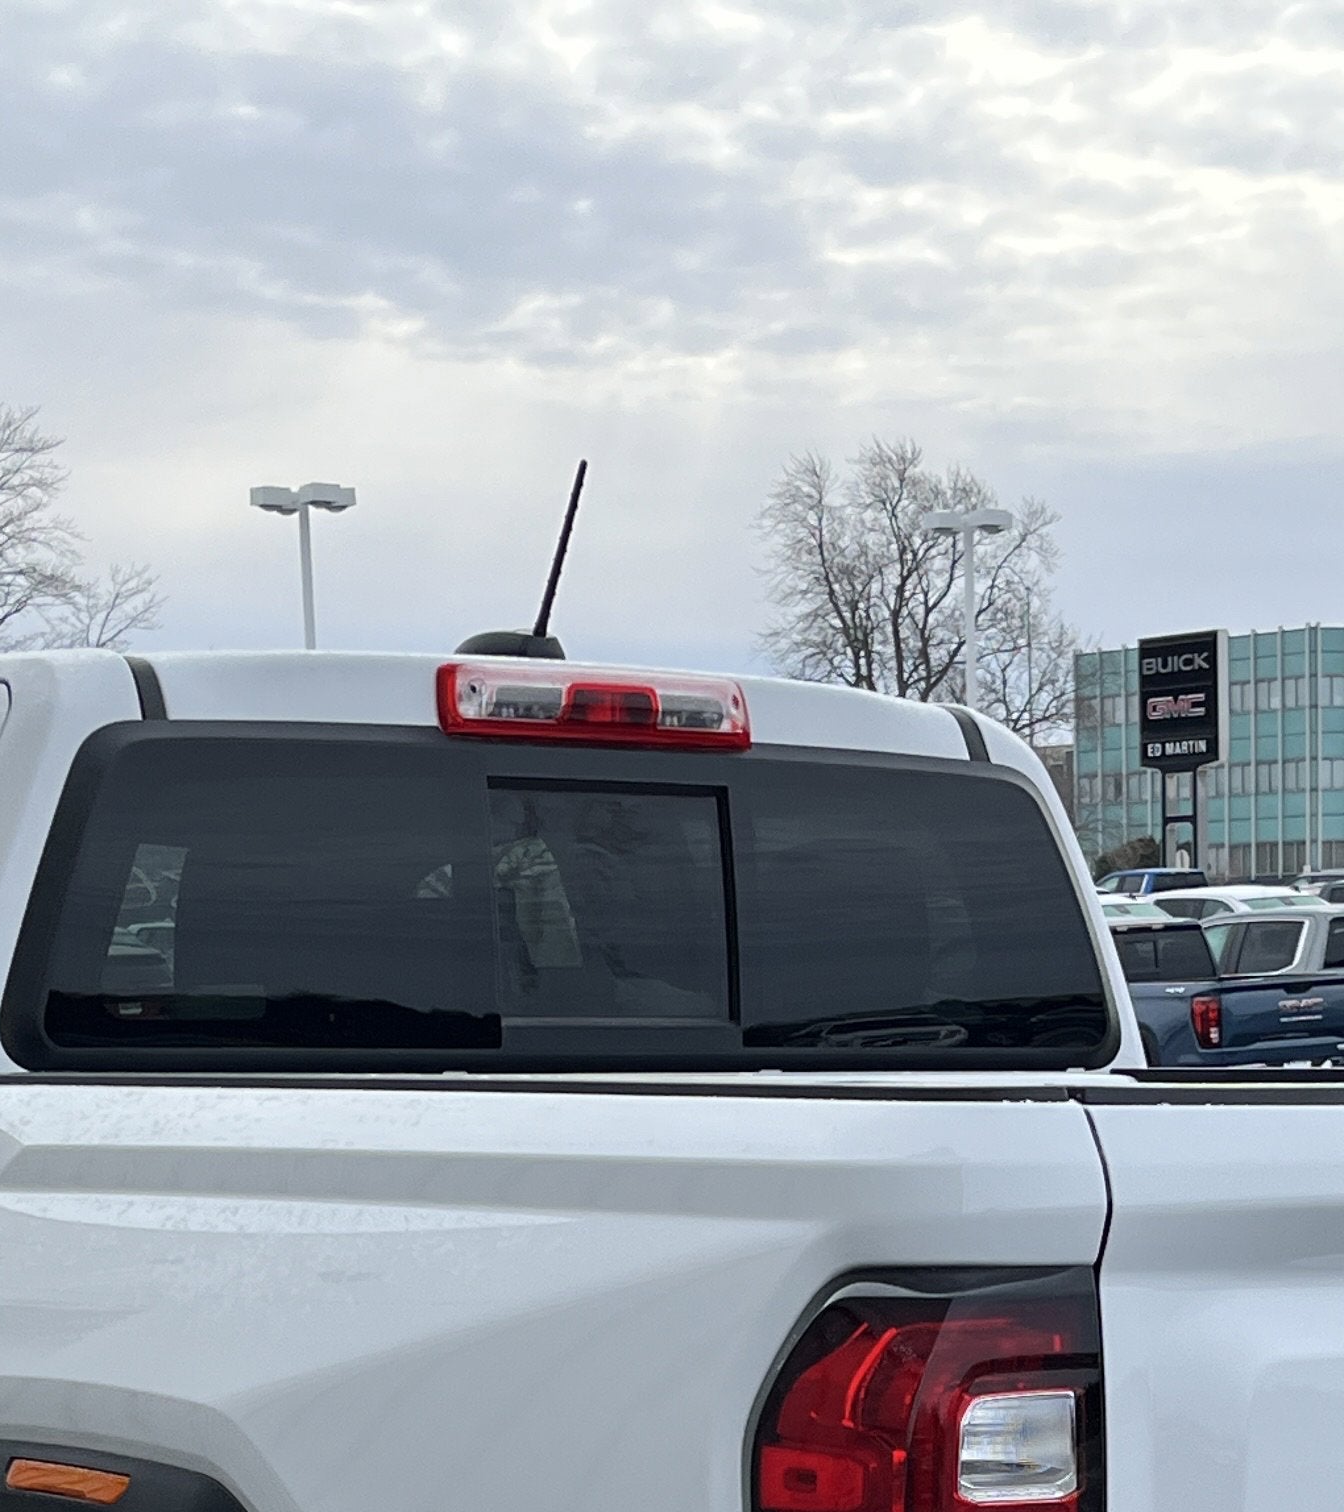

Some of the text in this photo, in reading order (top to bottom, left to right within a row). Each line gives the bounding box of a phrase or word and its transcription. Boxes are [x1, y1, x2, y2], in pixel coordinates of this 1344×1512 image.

[1142, 652, 1209, 675] BUICK
[1147, 693, 1205, 719] GMC
[1147, 740, 1207, 757] ED MARTIN
